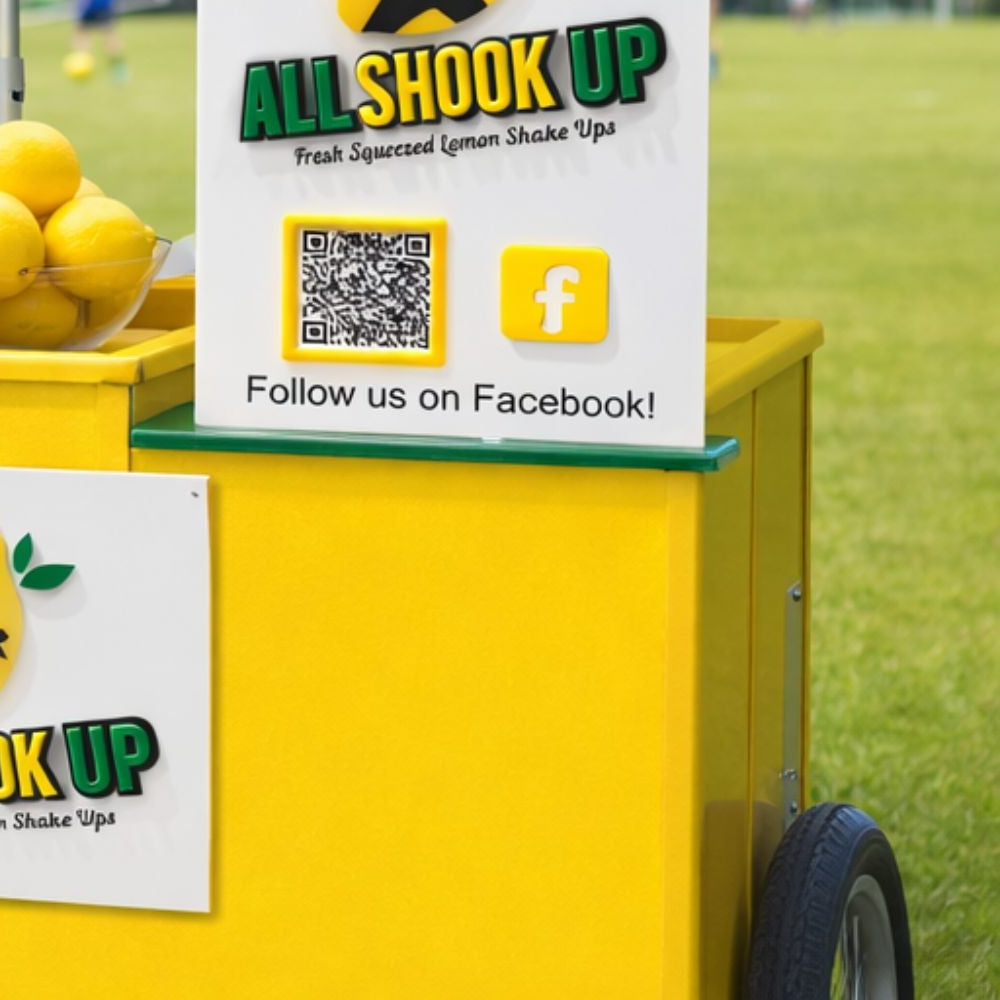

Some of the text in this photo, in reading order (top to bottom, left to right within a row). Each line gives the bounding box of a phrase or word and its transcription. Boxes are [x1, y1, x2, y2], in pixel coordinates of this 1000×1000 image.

[240, 17, 668, 142] ALL SHOOK UP
[294, 118, 616, 166] Fresh Squeezed Lemon Shake Ups
[247, 375, 656, 419] Follow us on Facebook!
[62, 717, 161, 798] UP
[12, 812, 72, 830] Shake
[76, 809, 116, 833] Ups
